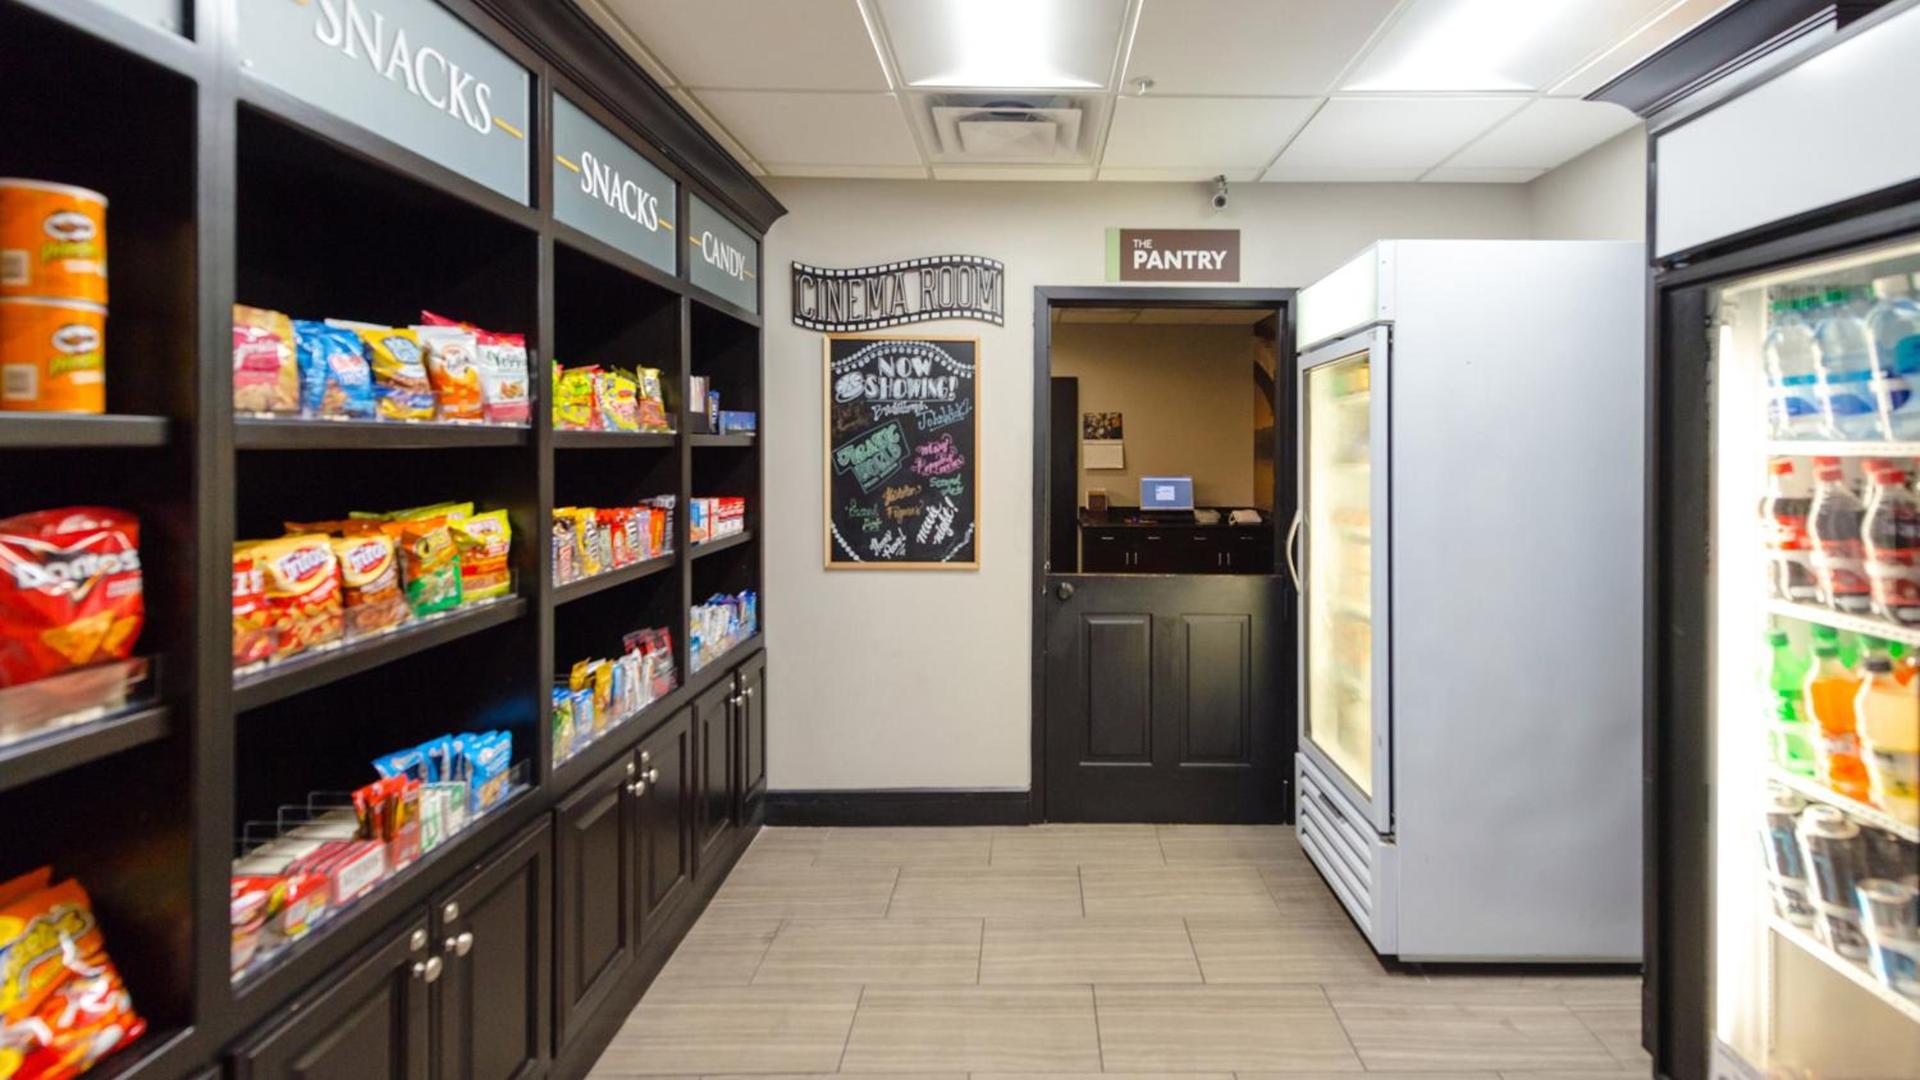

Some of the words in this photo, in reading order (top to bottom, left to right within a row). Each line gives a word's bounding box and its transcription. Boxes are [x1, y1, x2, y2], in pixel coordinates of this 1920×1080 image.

[316, 0, 491, 135] SNACKS
[581, 151, 658, 232] SNACKS
[702, 231, 746, 280] CANDY
[1133, 238, 1152, 249] THE
[1133, 250, 1227, 270] PANTRY
[796, 271, 908, 323] CINEMA
[919, 265, 999, 315] ROOM
[878, 356, 932, 378] NOW
[864, 375, 958, 401] SHOWING!
